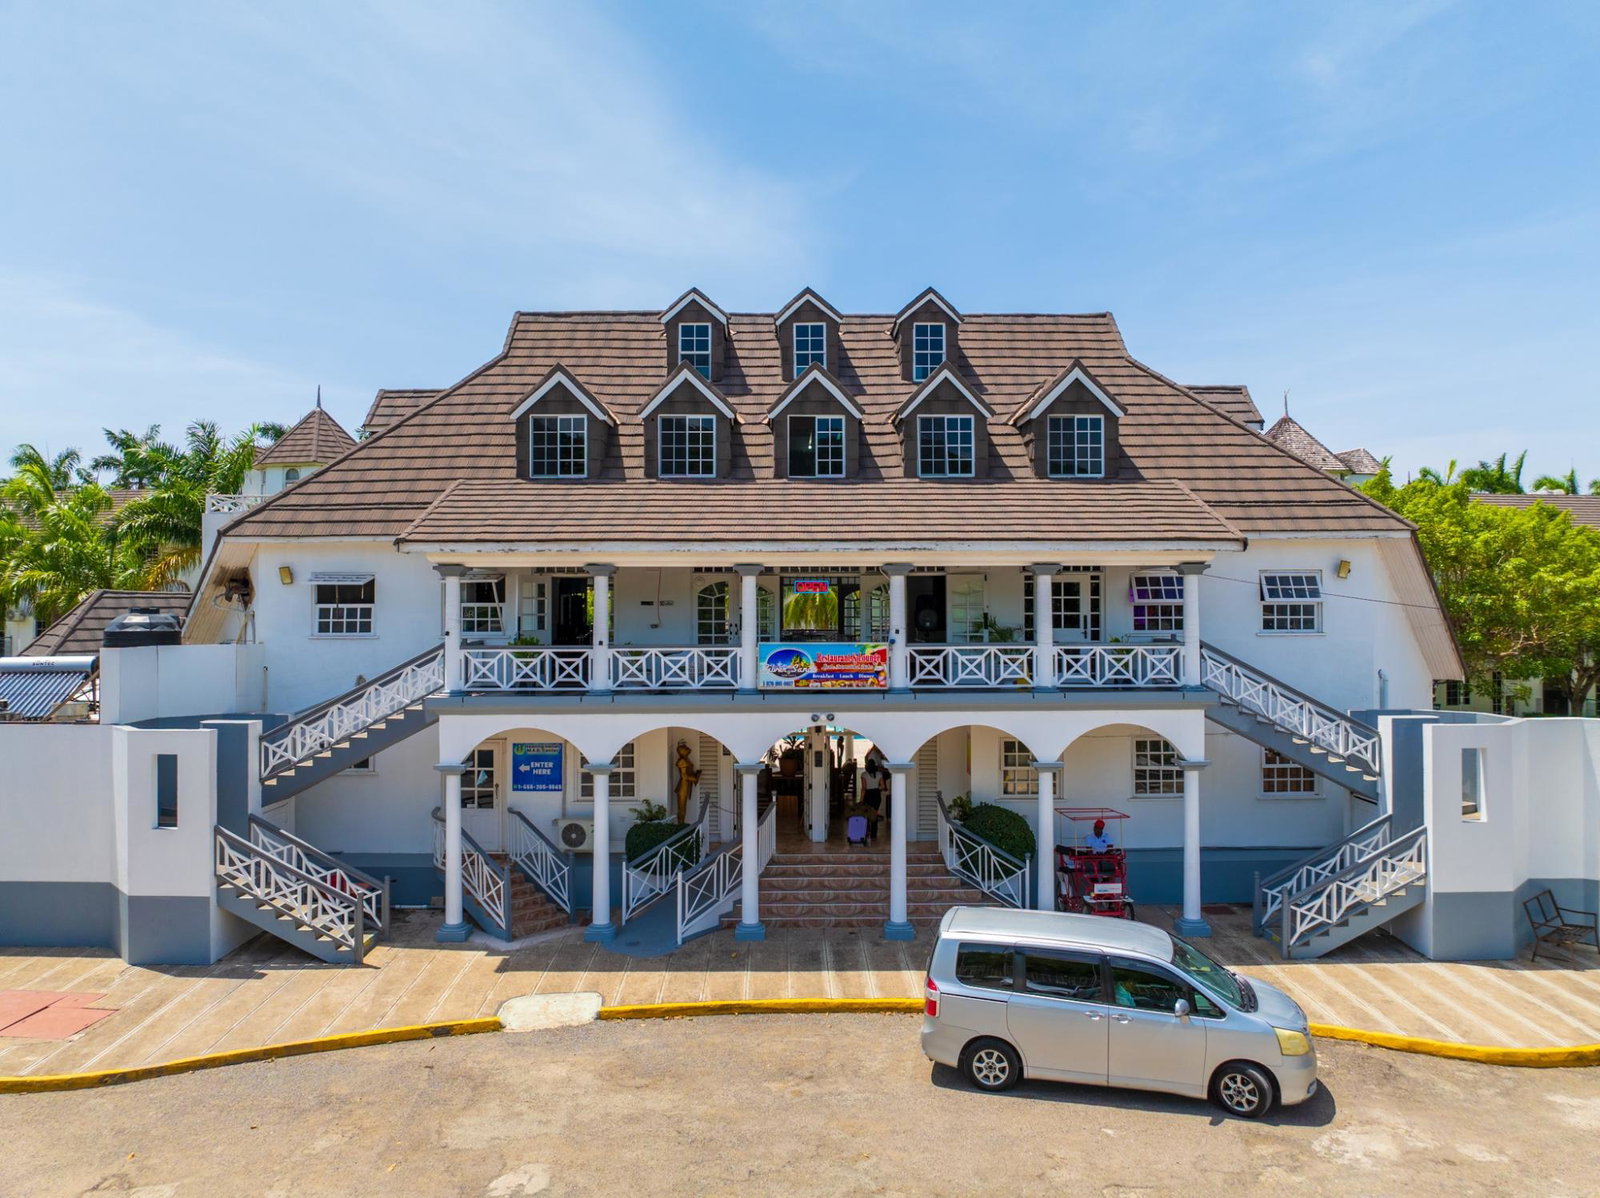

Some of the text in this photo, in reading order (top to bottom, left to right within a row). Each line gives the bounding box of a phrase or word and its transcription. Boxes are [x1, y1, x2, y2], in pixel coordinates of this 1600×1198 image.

[796, 581, 828, 592] OPEN
[817, 653, 850, 662] Restaurant
[858, 654, 881, 665] Lounge
